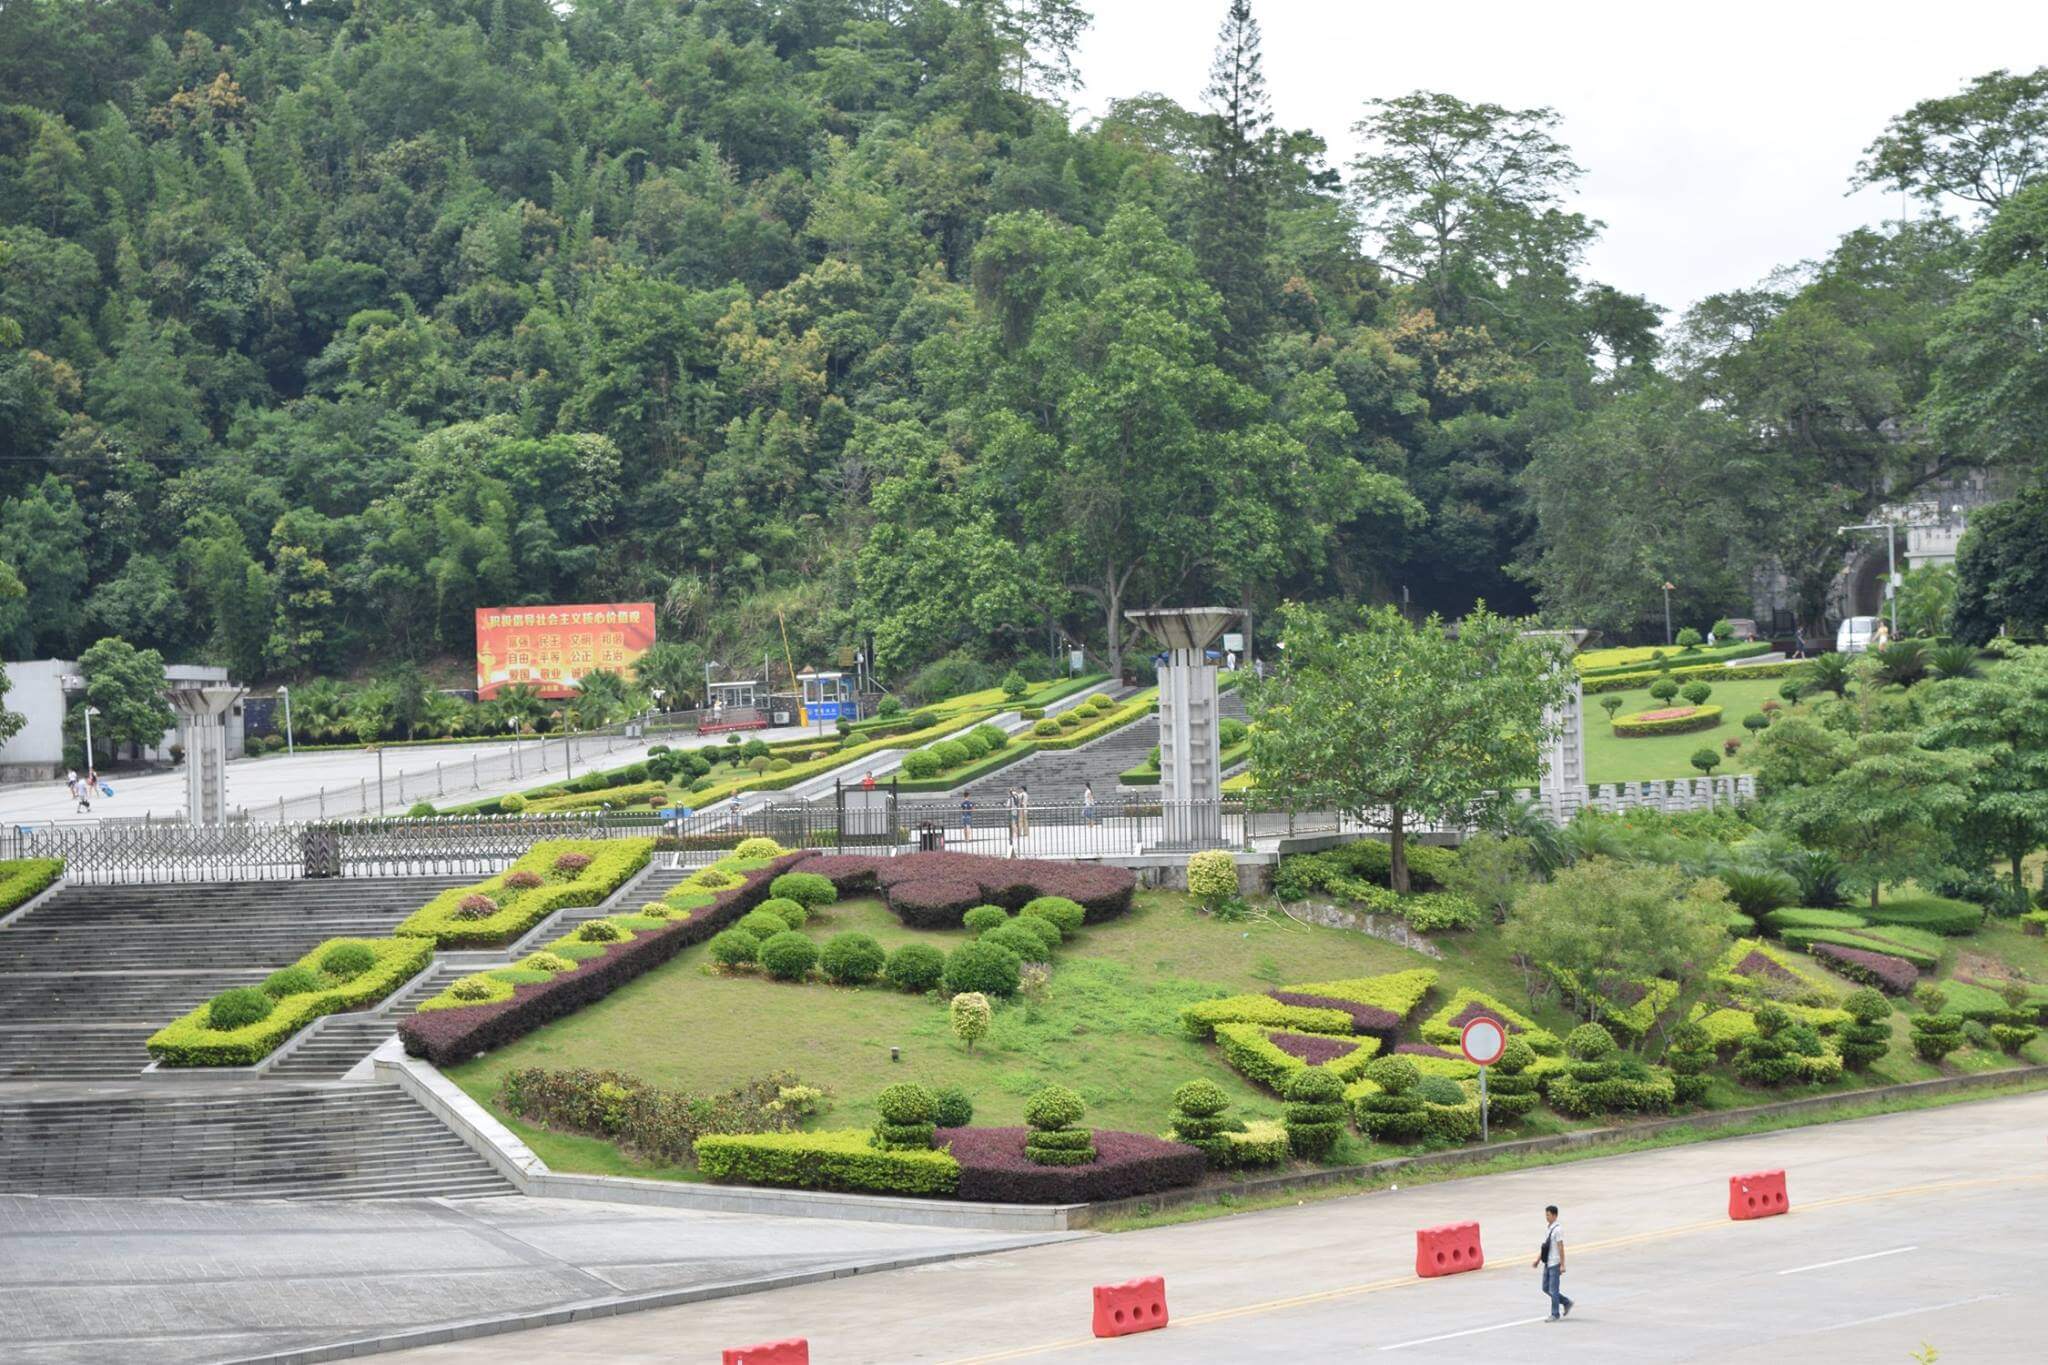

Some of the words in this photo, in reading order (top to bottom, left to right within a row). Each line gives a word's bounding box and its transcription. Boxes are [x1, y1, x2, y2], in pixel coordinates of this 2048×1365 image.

[508, 653, 529, 665] 自由
[540, 652, 560, 664] 平等
[571, 651, 592, 662] 公正
[602, 650, 623, 661] 法治
